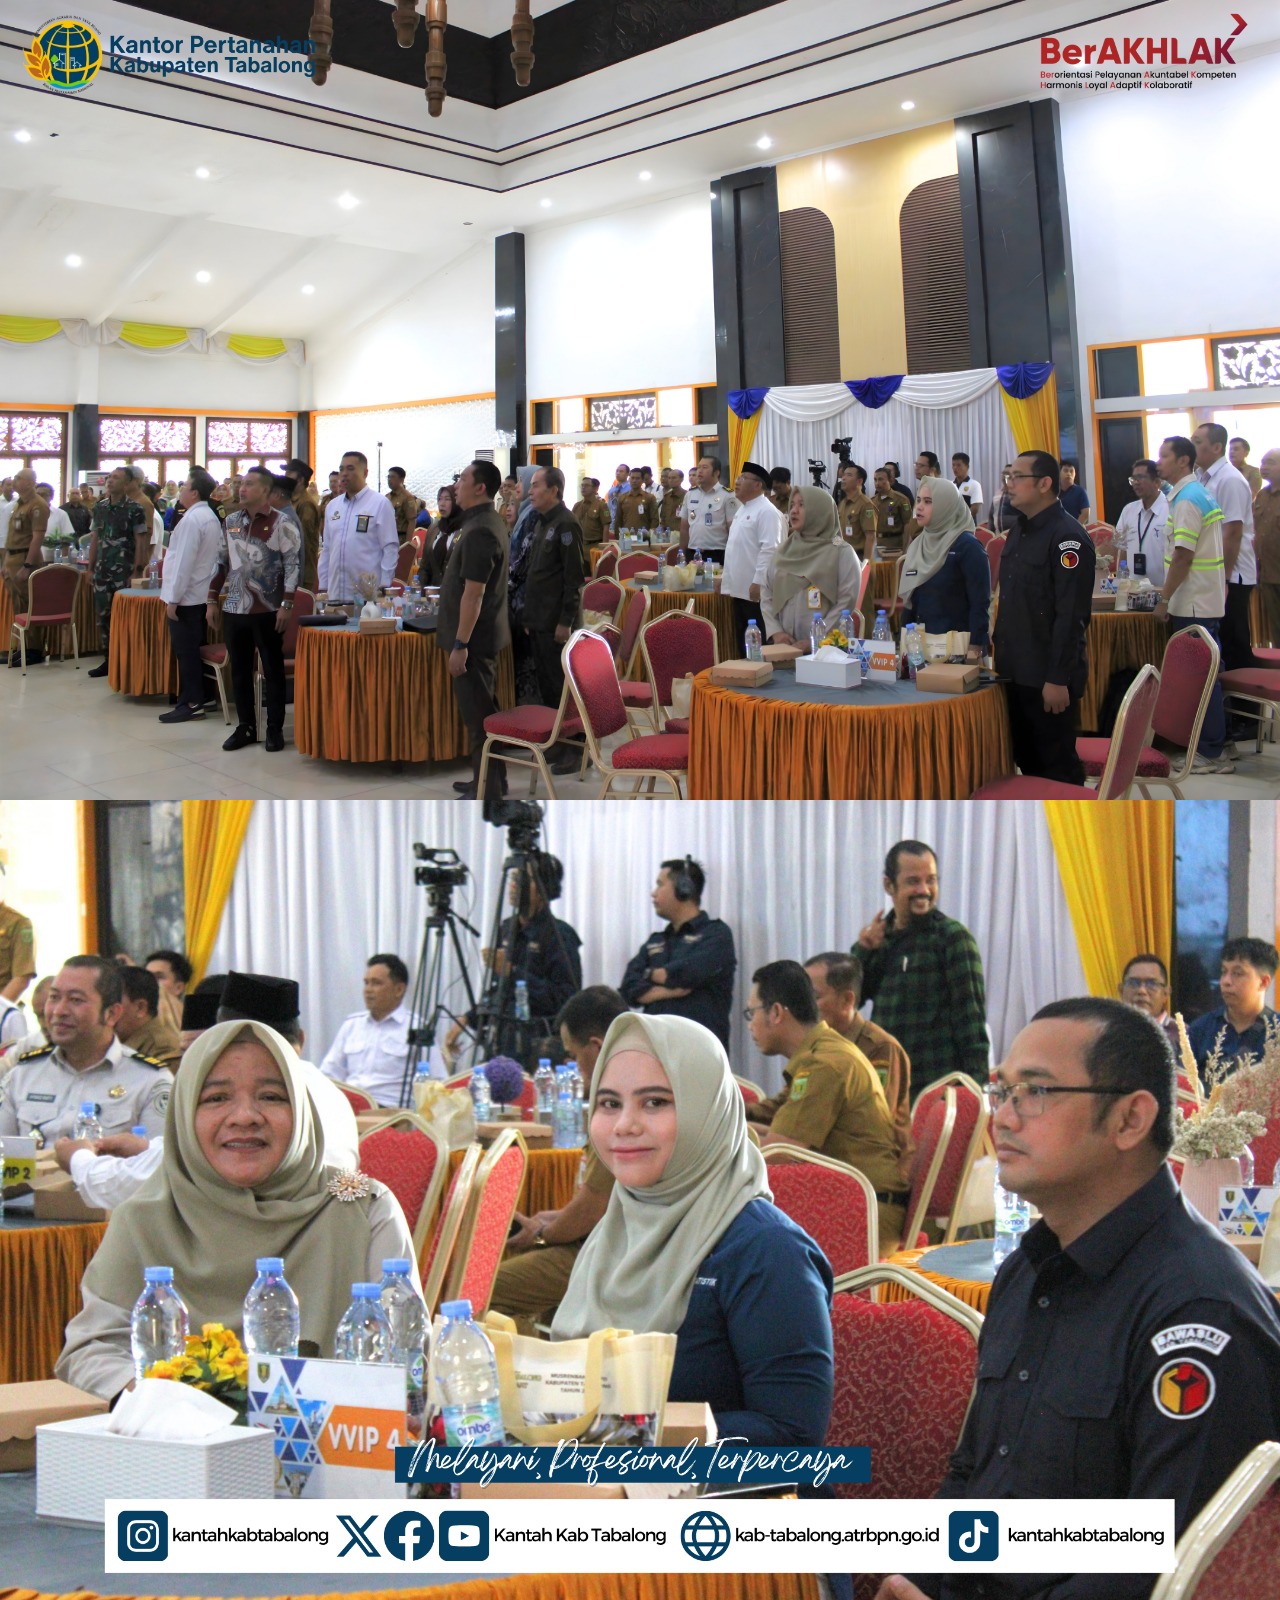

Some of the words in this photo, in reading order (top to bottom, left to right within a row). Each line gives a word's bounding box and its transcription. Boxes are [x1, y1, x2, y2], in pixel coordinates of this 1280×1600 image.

[872, 658, 888, 666] VVIP
[23, 1166, 31, 1180] 2
[328, 1422, 379, 1454] VVIP
[386, 1428, 401, 1450] 4
